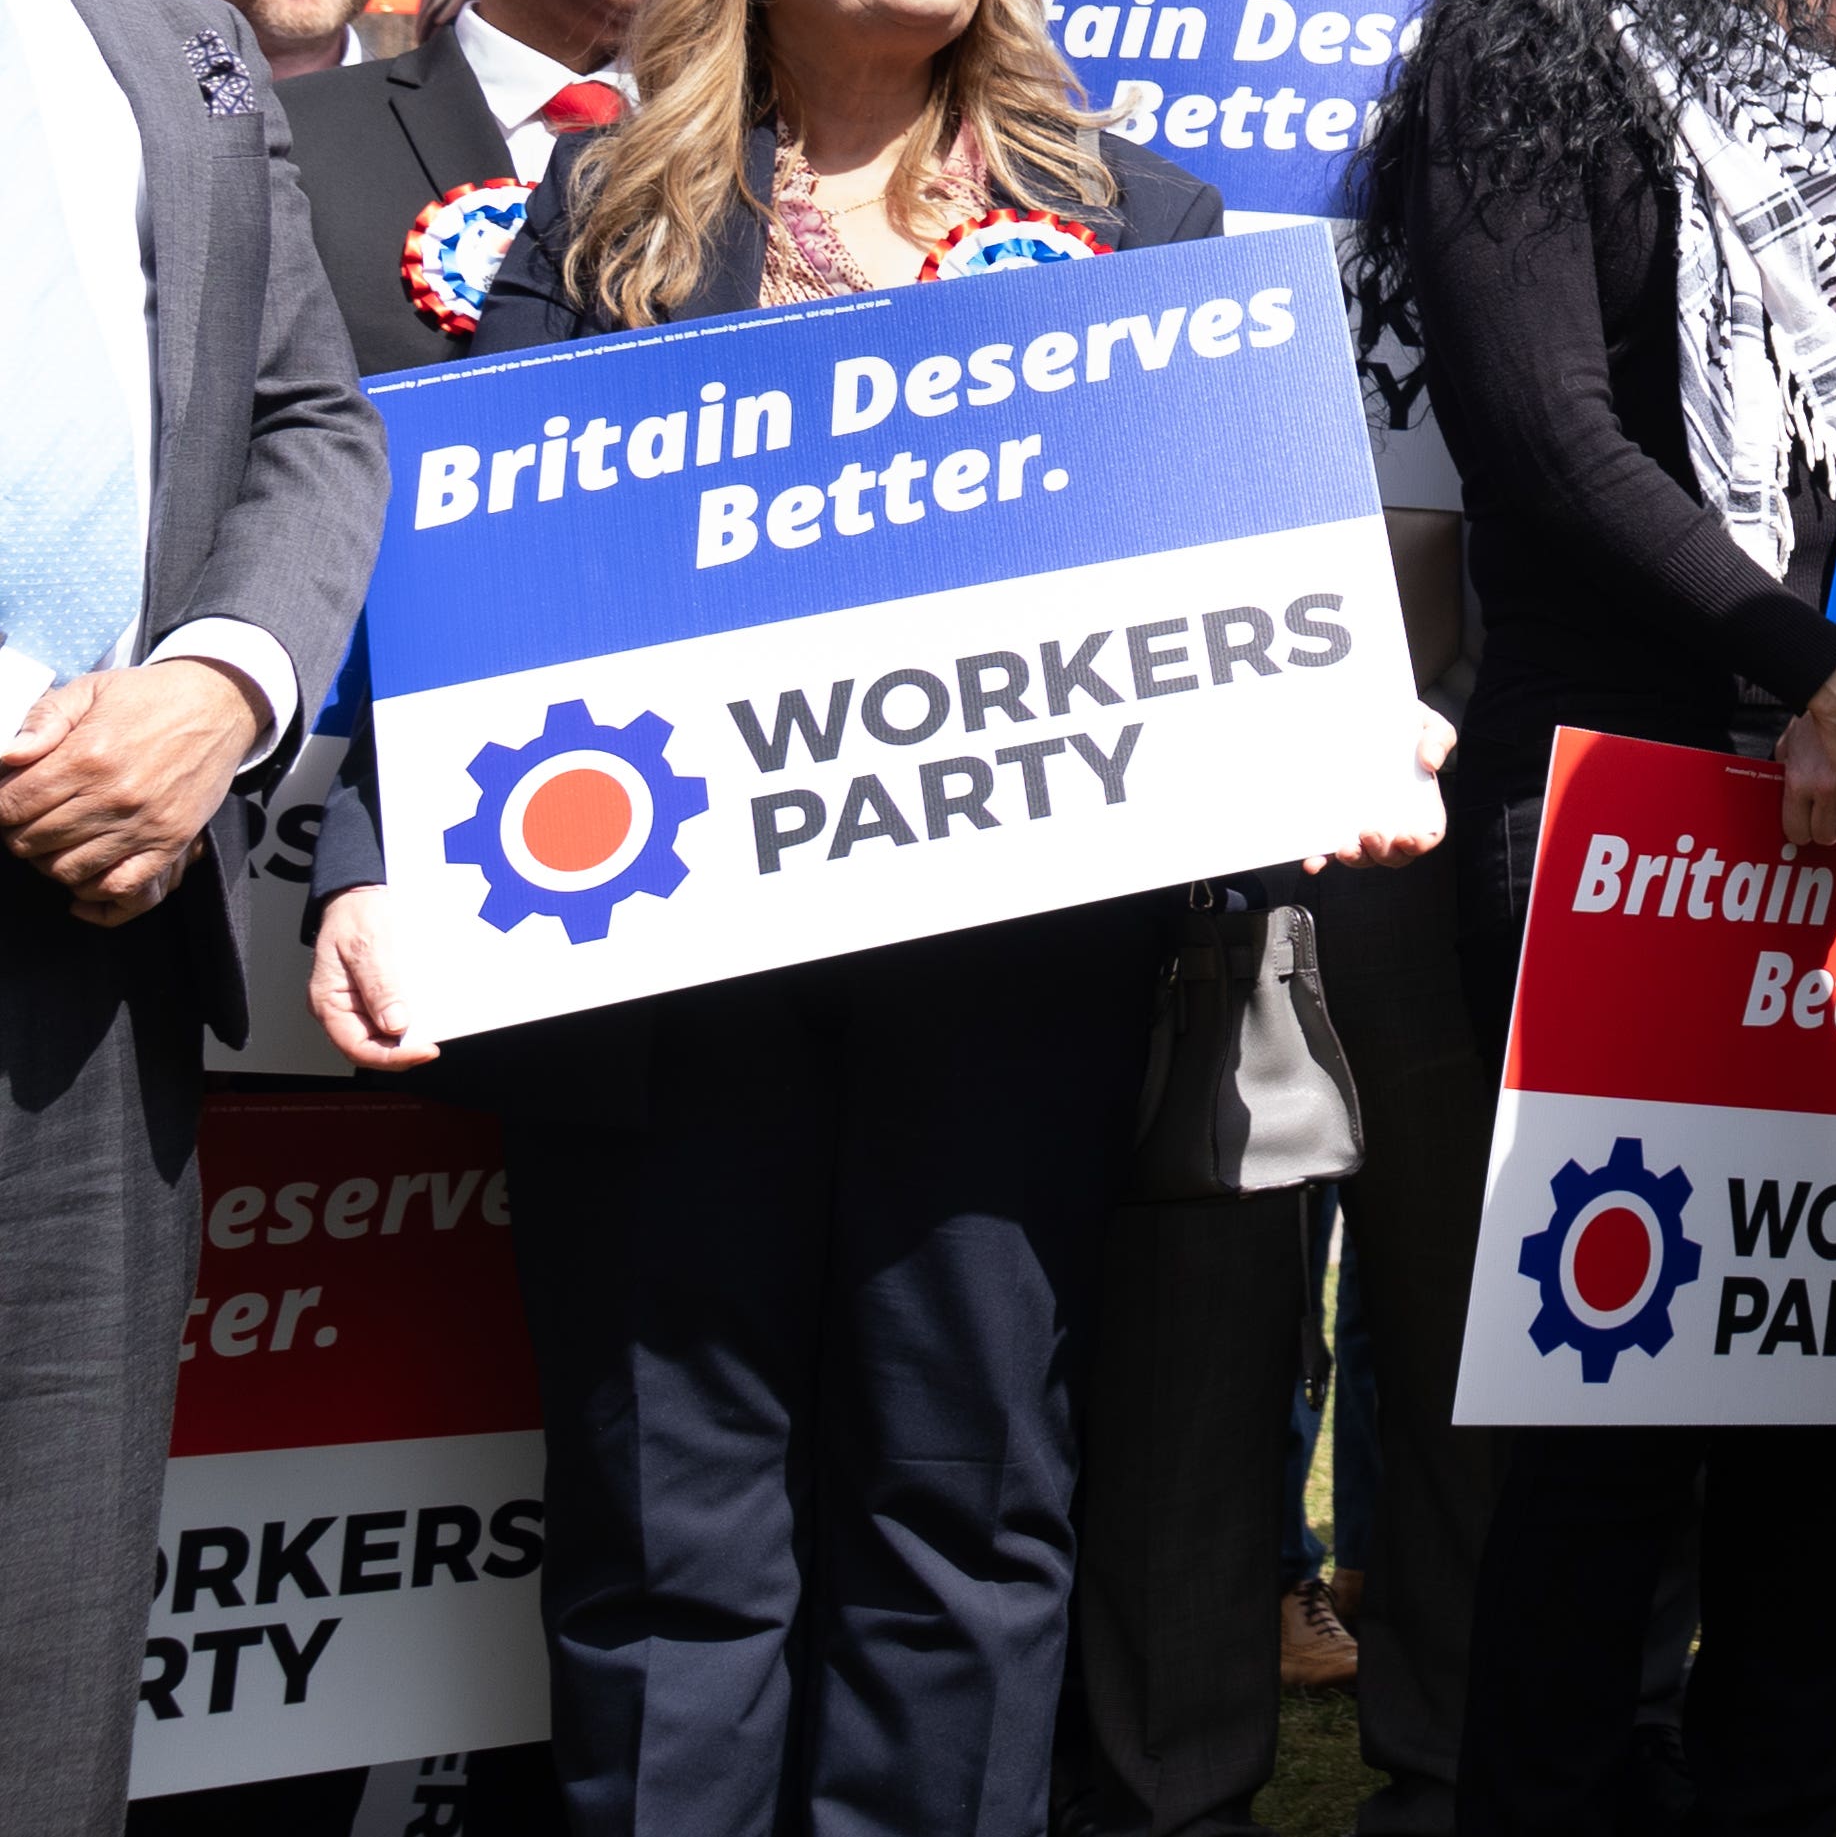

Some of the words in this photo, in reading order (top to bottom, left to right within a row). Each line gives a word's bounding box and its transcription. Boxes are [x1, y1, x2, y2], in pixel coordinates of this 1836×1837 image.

[1104, 79, 1385, 153] Bette
[414, 380, 793, 531] Britain
[830, 285, 1298, 438] Deserves
[696, 432, 1070, 570] Better.
[726, 593, 1353, 774] WORKERS
[750, 722, 1145, 876] PARTY
[1571, 833, 1834, 926] Britain
[155, 1498, 546, 1614] RKERS
[139, 1617, 344, 1721] RTY
